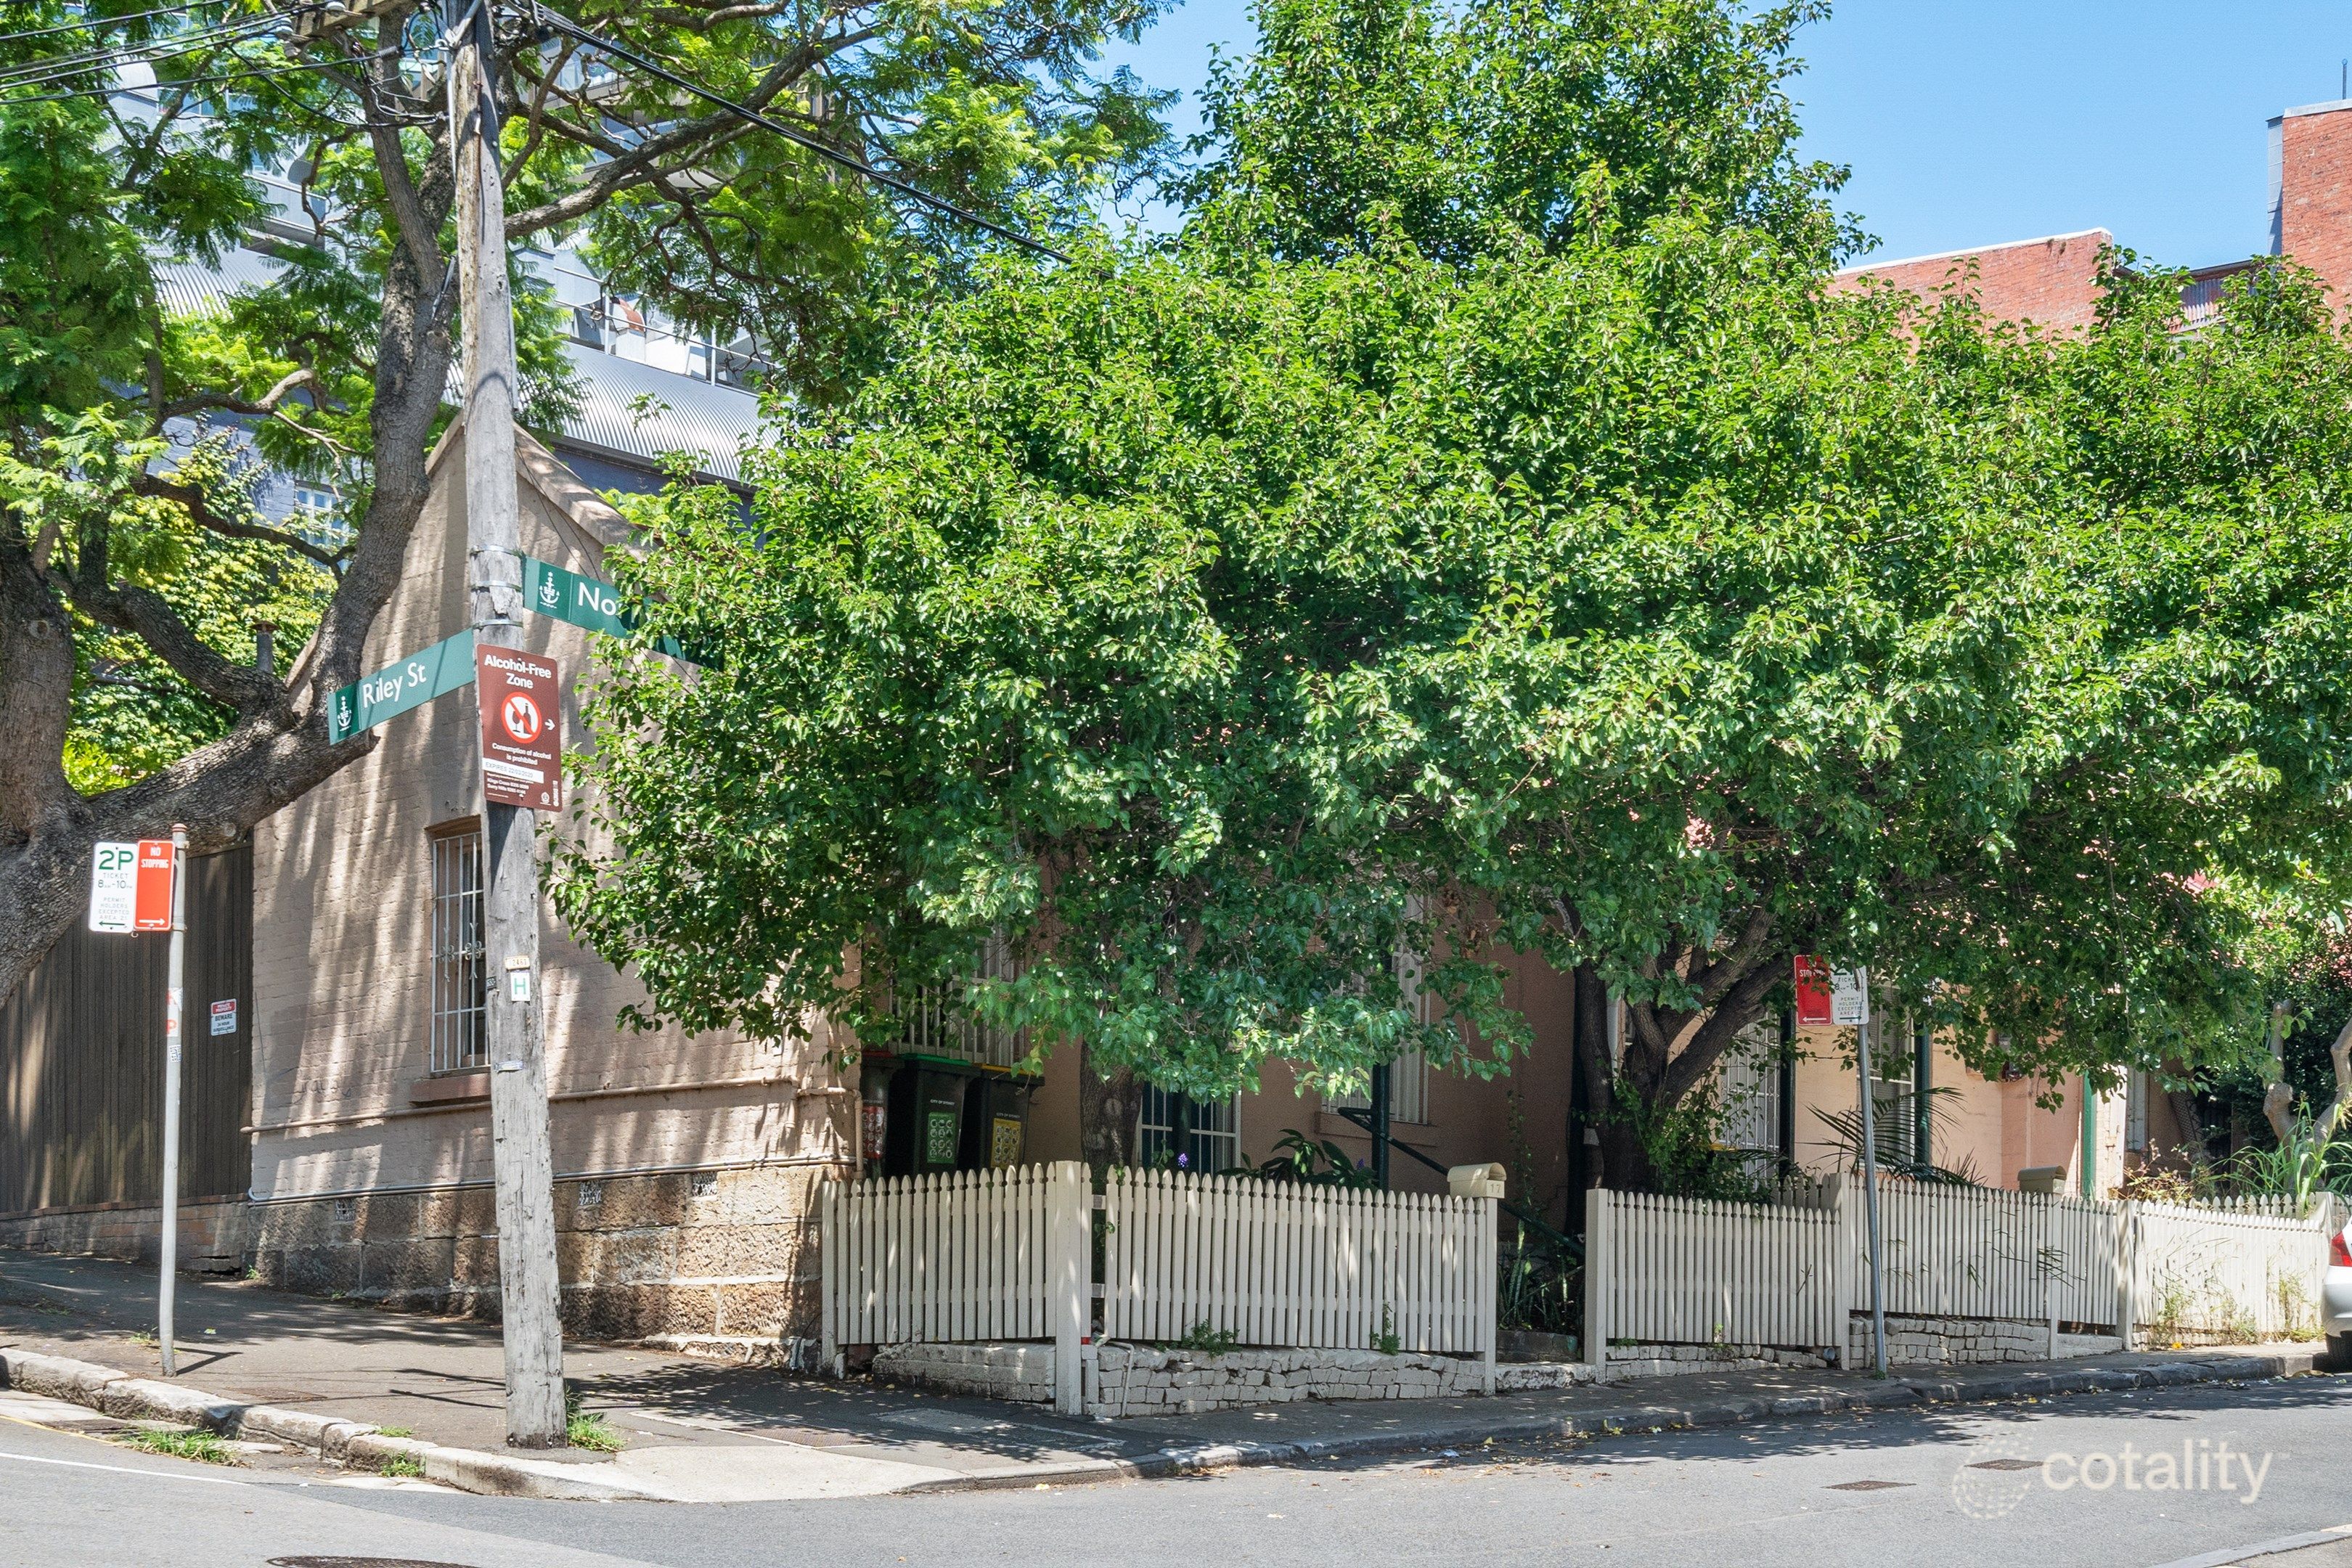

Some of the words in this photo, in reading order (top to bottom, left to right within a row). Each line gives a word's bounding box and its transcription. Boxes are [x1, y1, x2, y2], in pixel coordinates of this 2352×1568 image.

[484, 654, 552, 679] Alcohol-Free
[362, 676, 403, 709] Riley
[407, 662, 426, 687] St
[506, 672, 534, 689] Zone
[492, 743, 526, 754] Consumption
[98, 849, 134, 870] 2P
[150, 846, 161, 857] NO
[141, 859, 169, 868] STOPPING
[514, 978, 526, 995] H
[1490, 1183, 1502, 1193] 17
